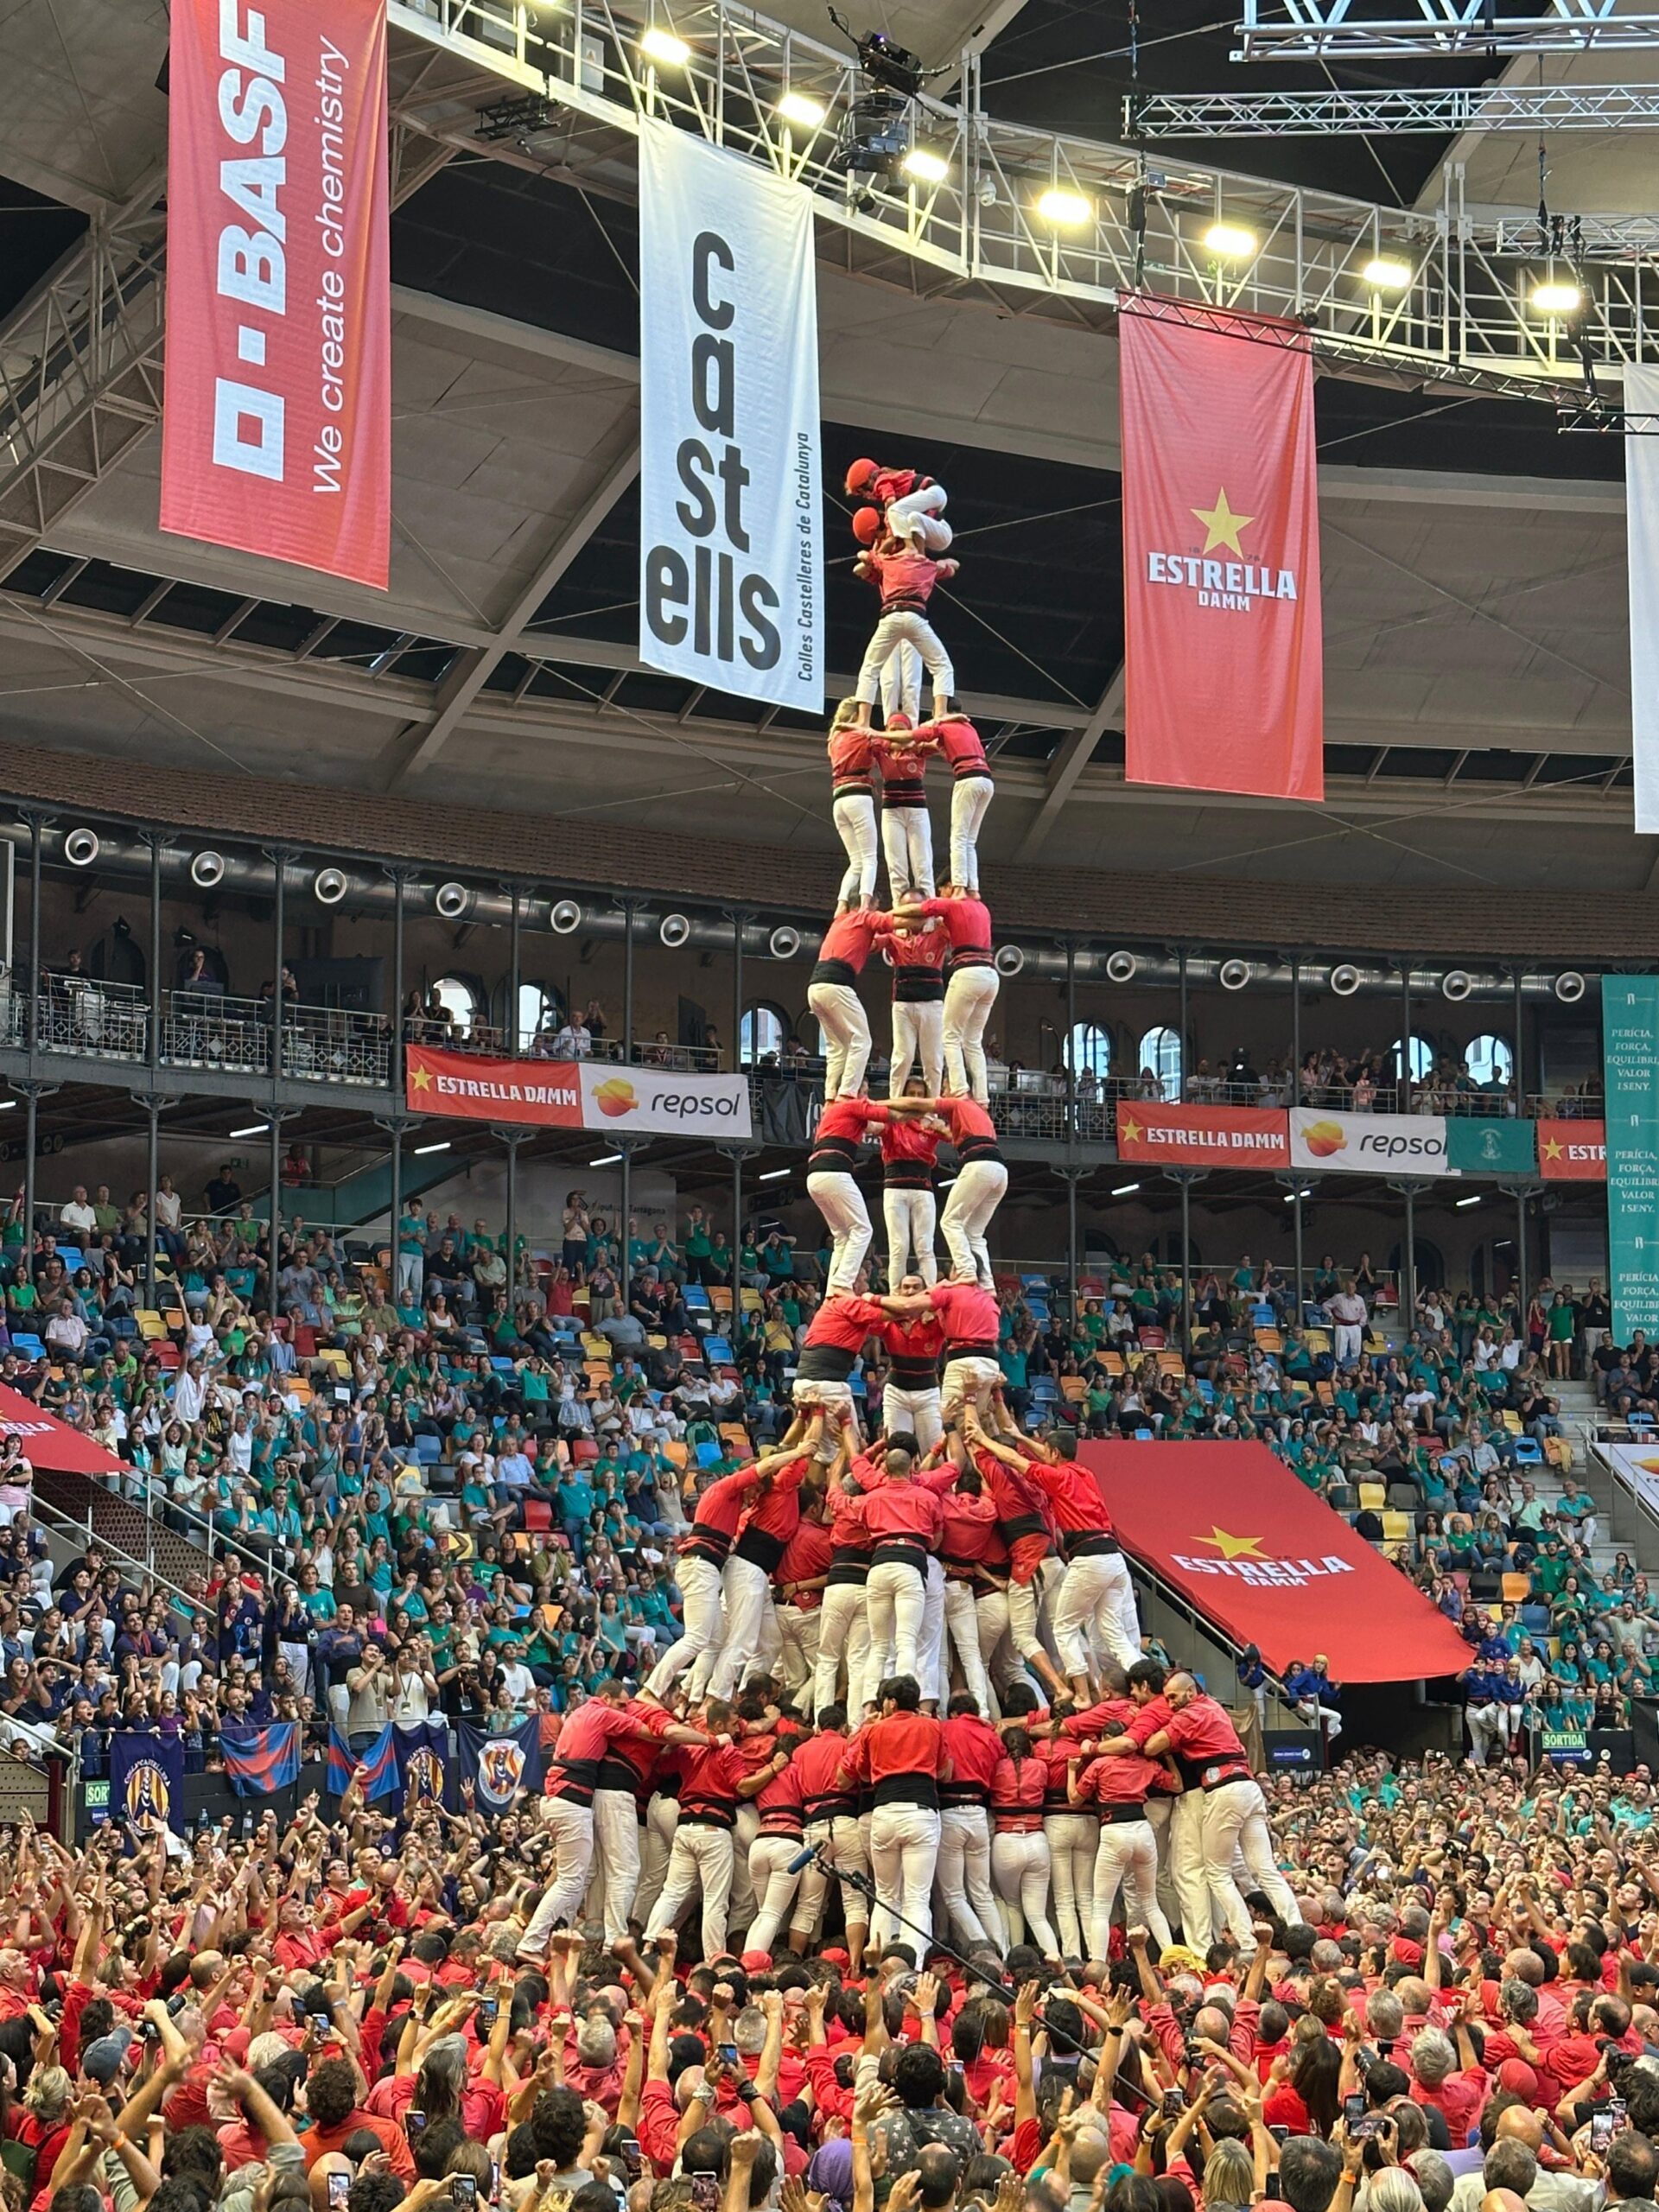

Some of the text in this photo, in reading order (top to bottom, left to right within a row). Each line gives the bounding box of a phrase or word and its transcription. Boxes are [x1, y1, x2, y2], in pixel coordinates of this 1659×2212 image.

[217, 0, 288, 316] BASF
[313, 34, 349, 493] We create chemistry
[795, 431, 813, 683] Colles Castelleres de Catalunya
[1147, 551, 1298, 601] ESTRELLA
[1198, 590, 1251, 612] DAMM
[1611, 1027, 1654, 1039] PERÍCIA,
[1615, 1042, 1651, 1054] FORÇA,
[1618, 1068, 1651, 1077] VALOR
[436, 1075, 577, 1106] ESTRELLA DAMM
[1618, 1082, 1651, 1091] I SENY.
[652, 1093, 741, 1118] repsol
[1147, 1127, 1285, 1149] ESTRELLA DAMM
[1615, 1148, 1657, 1160] PERÍCIA,
[1618, 1164, 1656, 1175] FORÇA,
[1621, 1191, 1656, 1199] VALOR
[1621, 1204, 1656, 1212] I SENY.
[1625, 1313, 1659, 1322] VALOR
[1625, 1326, 1630, 1336] I
[1169, 1554, 1356, 1578] ESTRELLA
[1241, 1575, 1309, 1586] DAMM
[1544, 1733, 1584, 1746] SORTIDA
[87, 1785, 110, 1802] SOR
